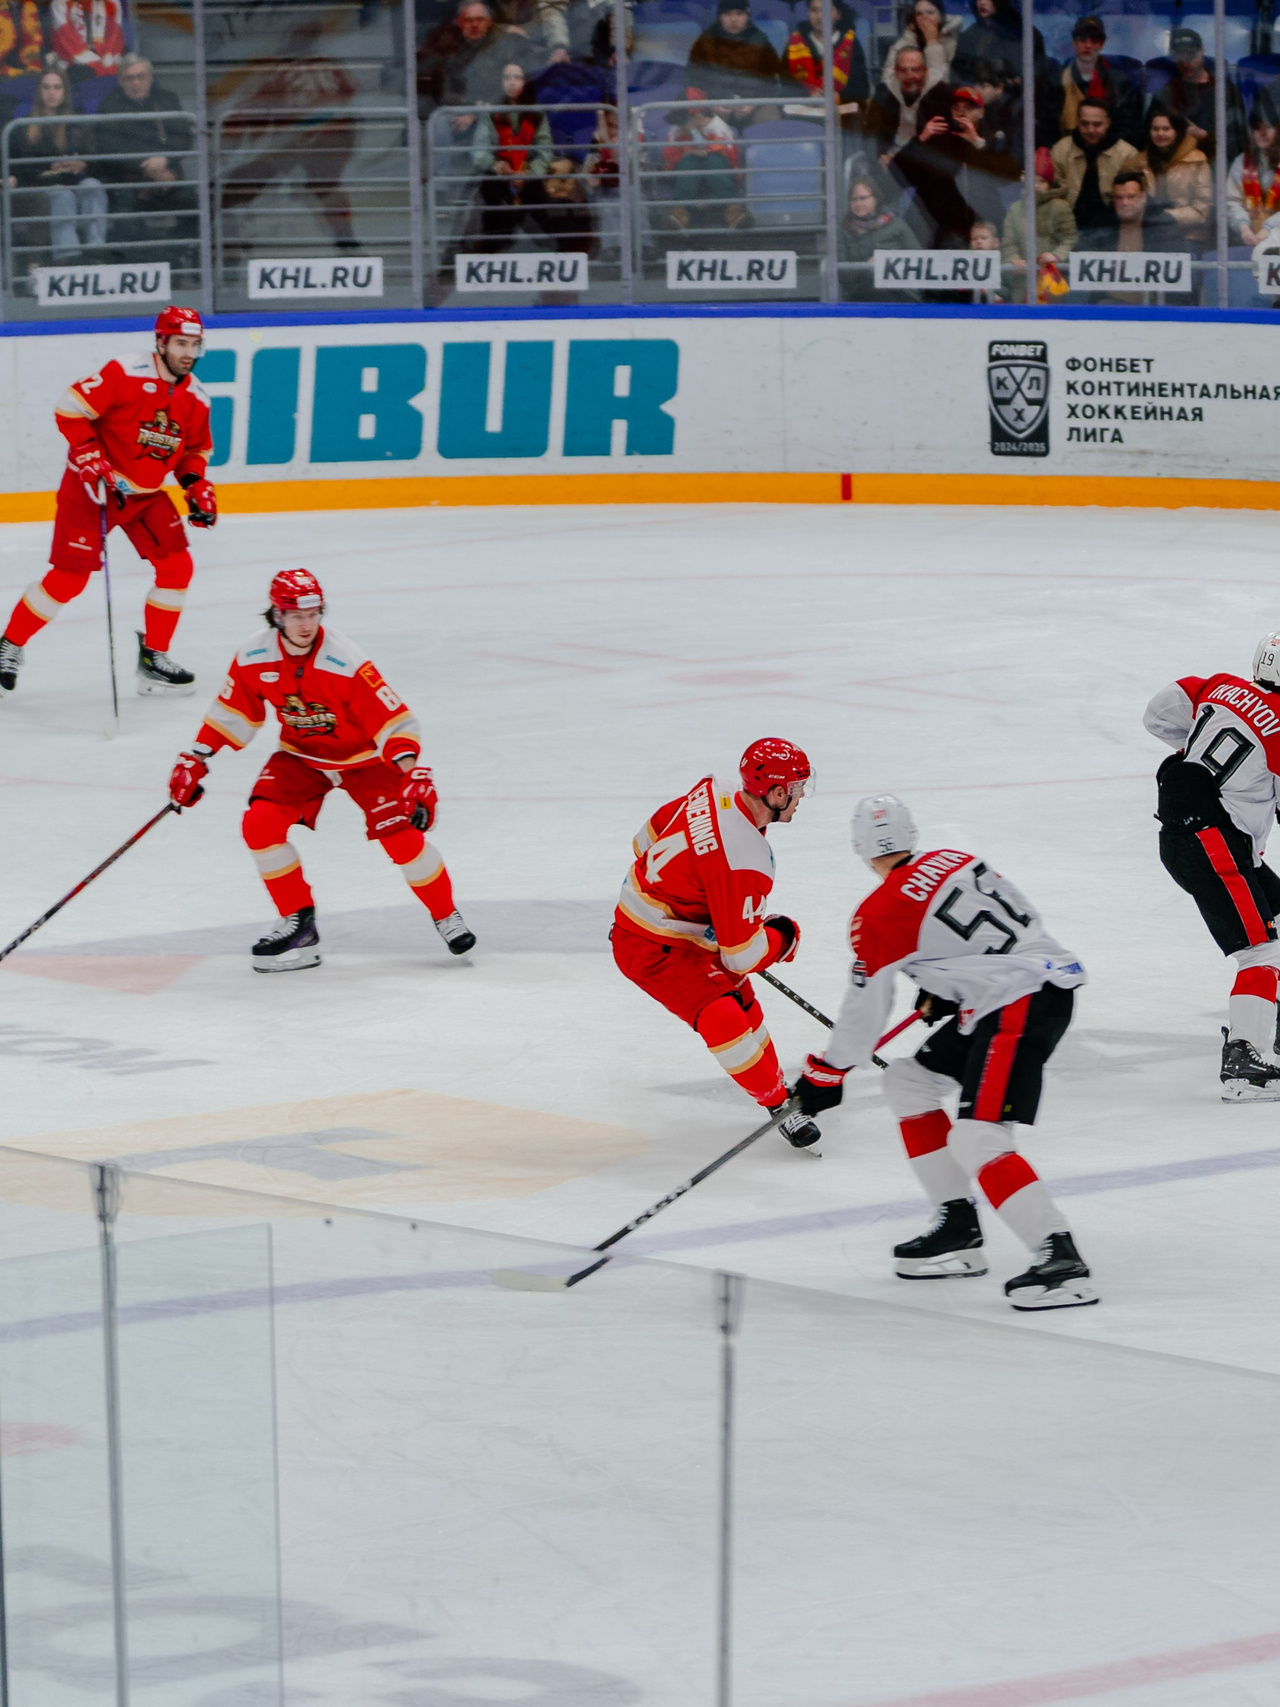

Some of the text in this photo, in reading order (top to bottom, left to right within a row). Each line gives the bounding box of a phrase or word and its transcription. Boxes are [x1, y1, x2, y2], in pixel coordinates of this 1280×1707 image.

[259, 265, 373, 290] KHL.RU
[465, 259, 580, 284] KHL.RU
[676, 258, 789, 282] KHL.RU
[882, 256, 992, 282] KHL.RU
[1077, 257, 1183, 284] KHL.RU
[48, 270, 161, 298] KHL.RU
[991, 344, 1045, 357] FONBET
[1065, 357, 1155, 374] ФОНБЕТ
[1066, 402, 1204, 422] ХОККЕЙНАЯ
[1066, 427, 1124, 444] ЛИГА
[1260, 651, 1276, 667] 19
[1182, 703, 1257, 791] 19
[742, 895, 767, 924] 44
